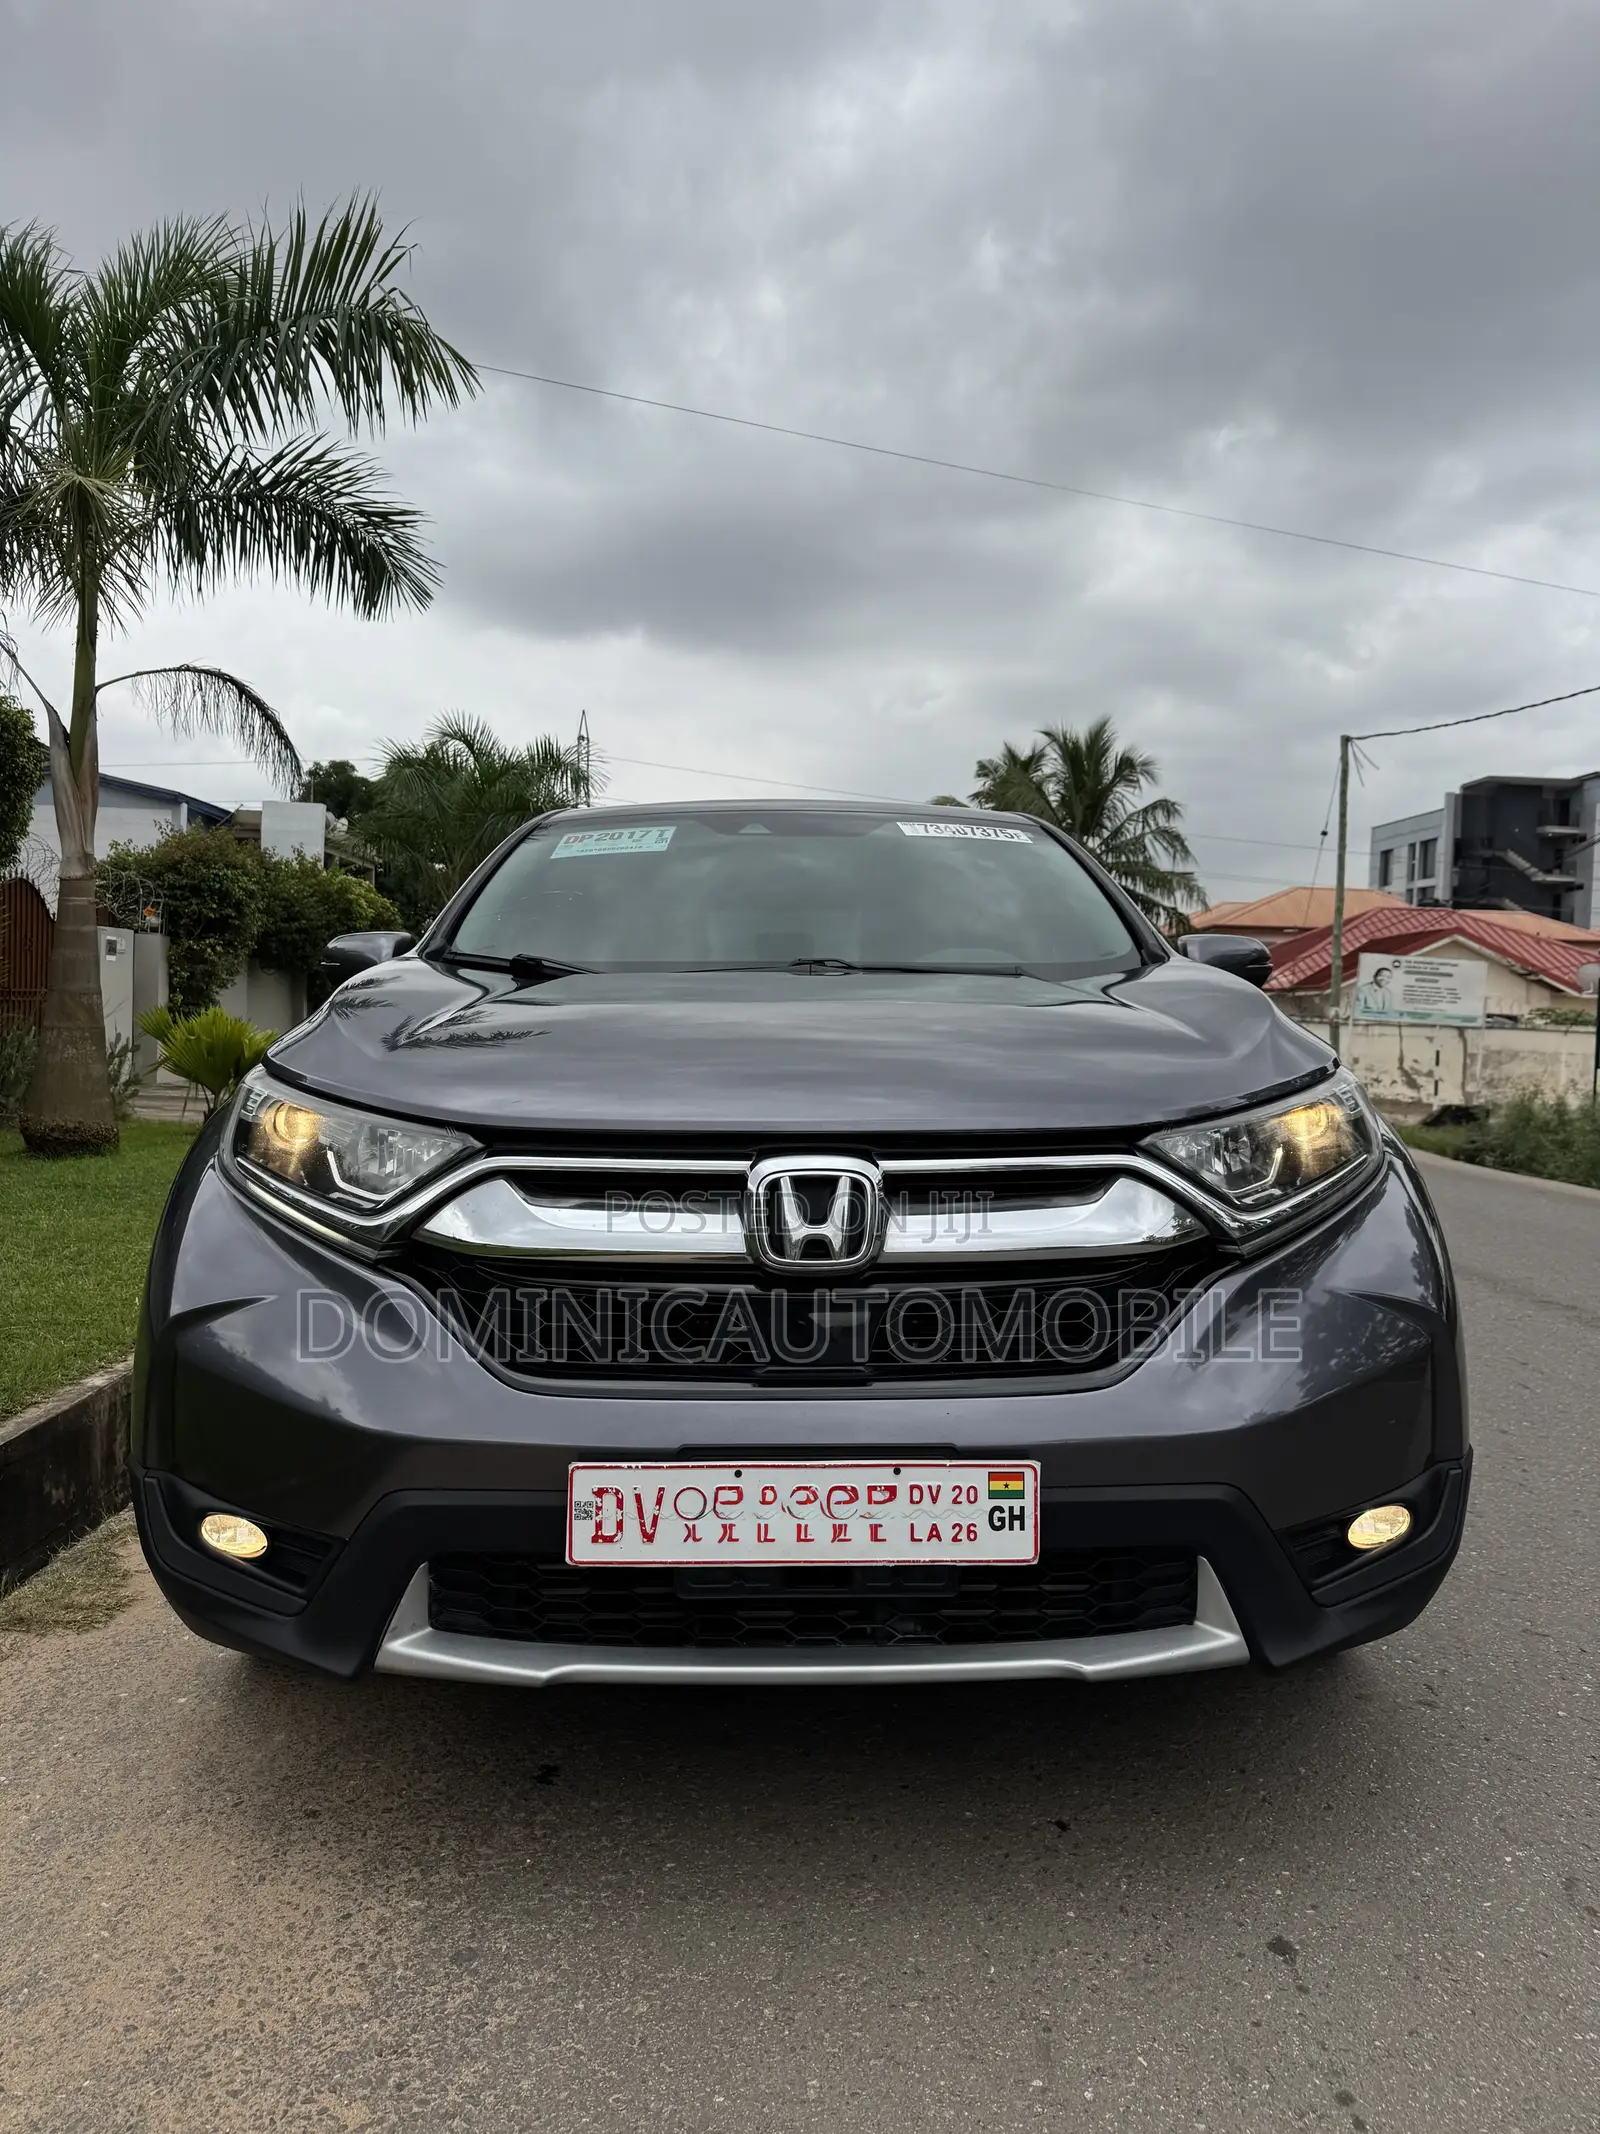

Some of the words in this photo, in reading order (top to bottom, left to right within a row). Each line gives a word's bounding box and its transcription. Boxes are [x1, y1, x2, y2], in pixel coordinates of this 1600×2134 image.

[909, 1483, 942, 1505] DV
[951, 1484, 979, 1505] 20
[988, 1505, 1026, 1532] GH
[909, 1522, 943, 1543] LA
[951, 1522, 979, 1543] 26
